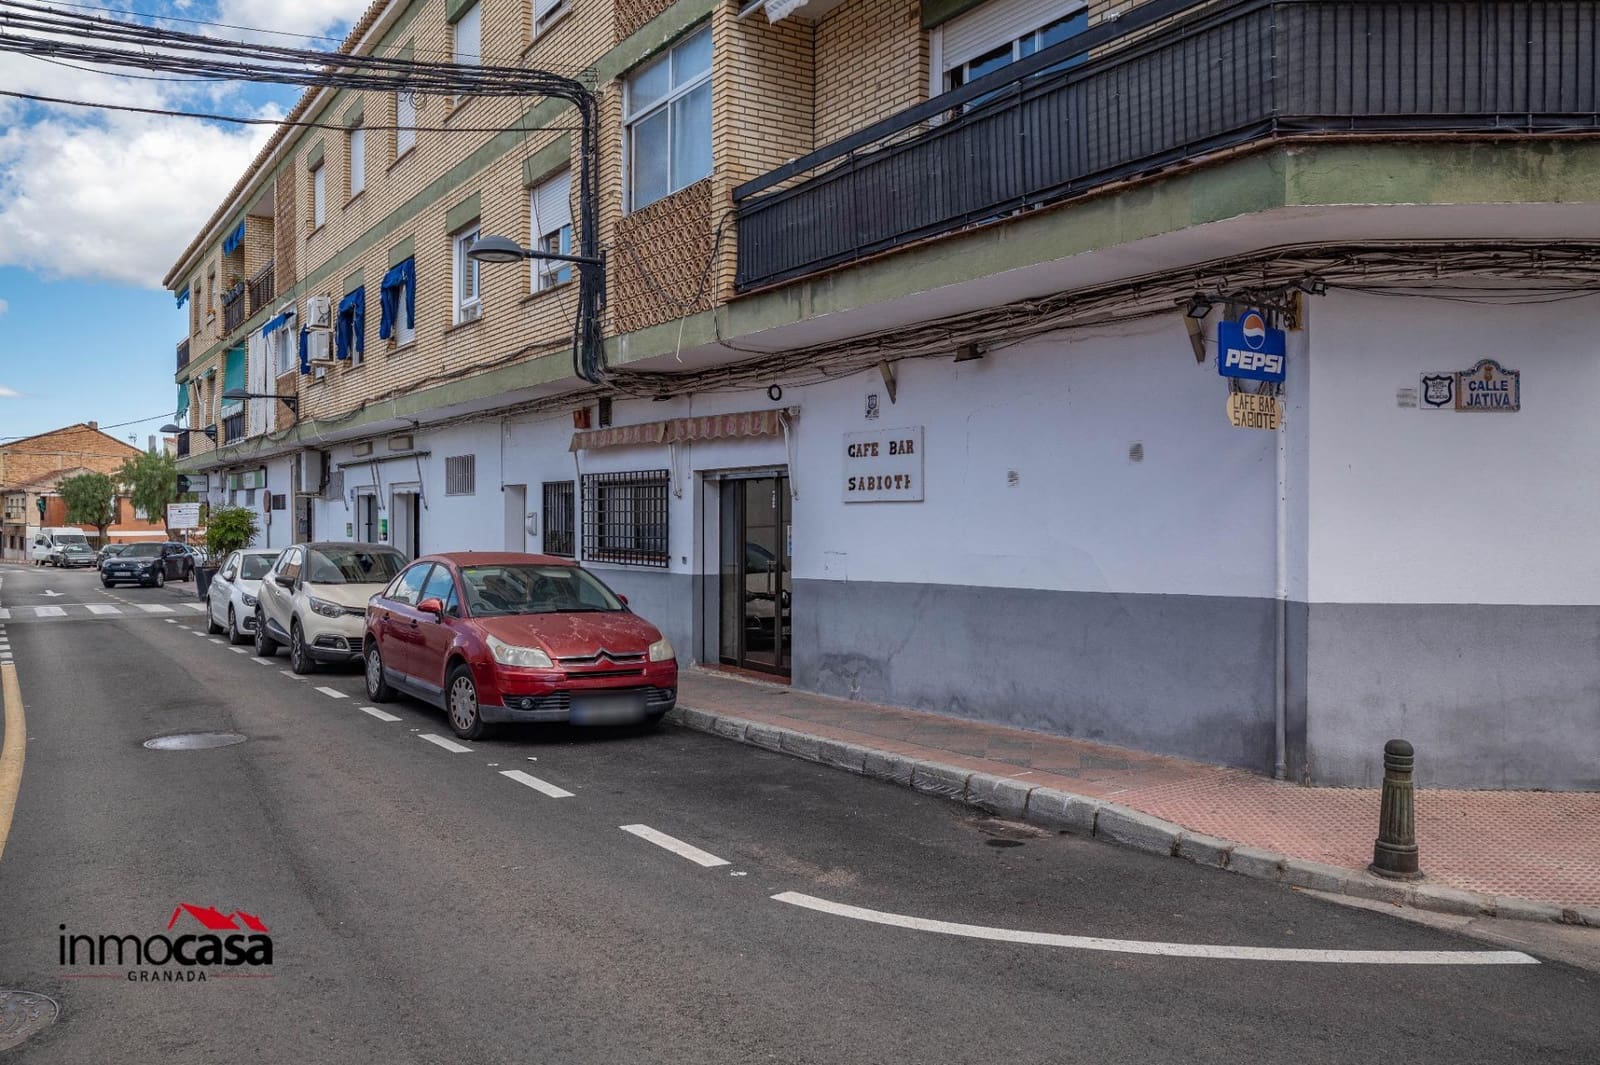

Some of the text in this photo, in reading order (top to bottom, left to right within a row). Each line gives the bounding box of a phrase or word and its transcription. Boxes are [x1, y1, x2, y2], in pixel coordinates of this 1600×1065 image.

[1225, 348, 1283, 374] PEPSI
[1468, 380, 1509, 392] CALLE
[1233, 394, 1276, 413] CAFE BAR
[1466, 393, 1511, 406] JATIVA
[1233, 410, 1276, 430] SABIOTE
[847, 439, 915, 458] CAFE BAR
